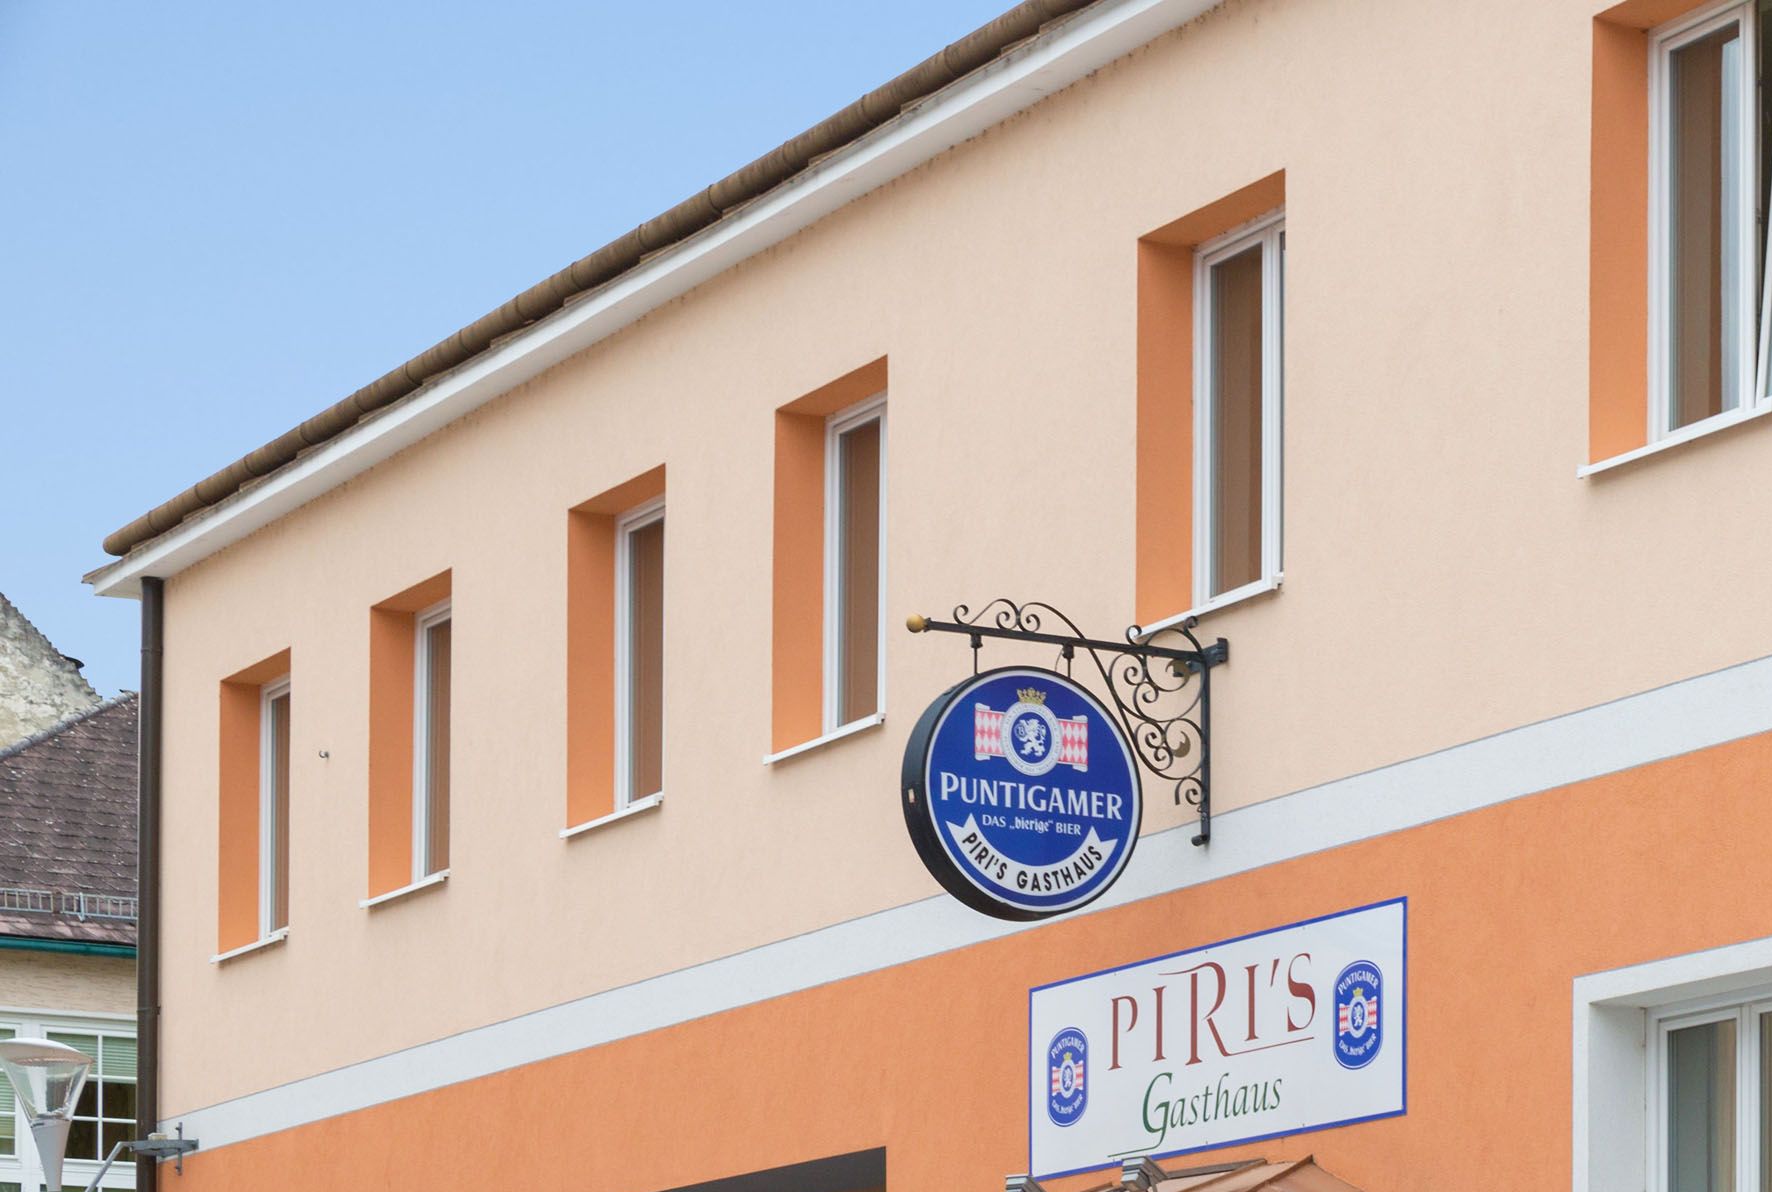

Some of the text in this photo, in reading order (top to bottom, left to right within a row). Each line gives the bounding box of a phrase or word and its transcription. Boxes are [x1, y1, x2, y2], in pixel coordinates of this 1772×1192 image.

[940, 772, 1123, 820] PUNTIGAMER
[982, 814, 1006, 828] DAS
[1055, 822, 1082, 836] BIER
[962, 832, 1103, 892] PIRI'S GASTHAUS
[1107, 953, 1316, 1071] PIRI'S
[1108, 1072, 1283, 1157] Gasthaus
